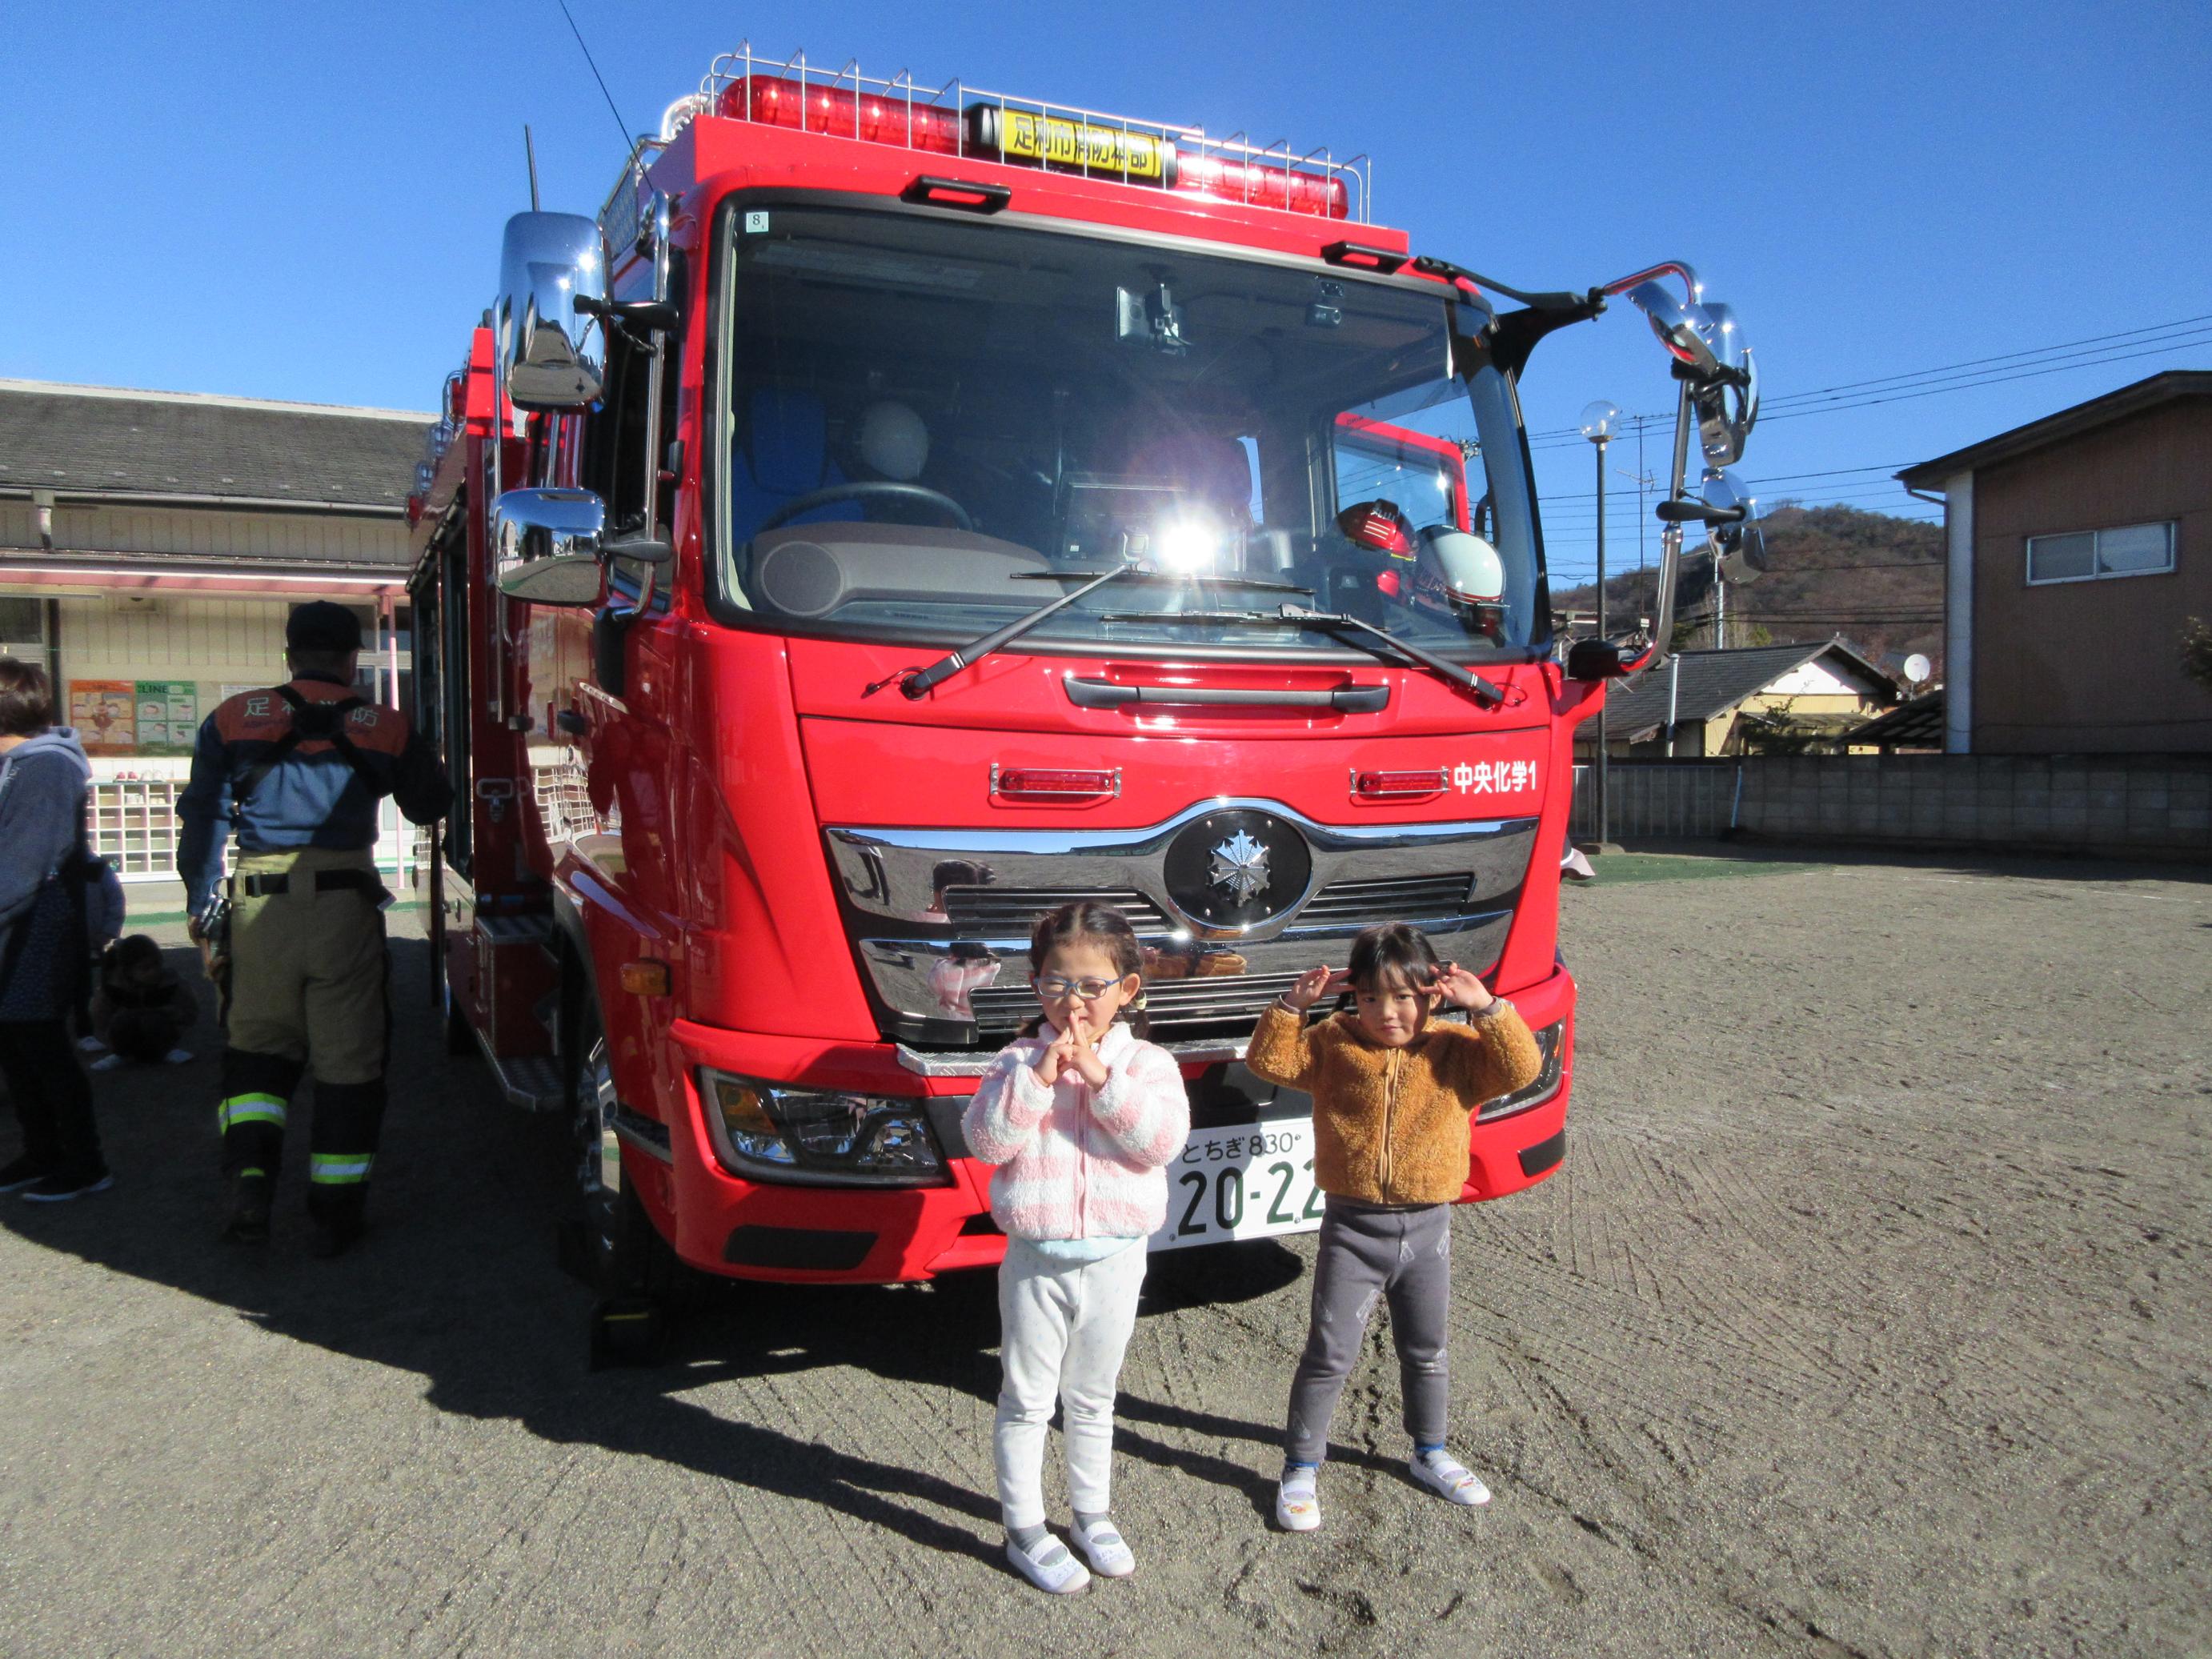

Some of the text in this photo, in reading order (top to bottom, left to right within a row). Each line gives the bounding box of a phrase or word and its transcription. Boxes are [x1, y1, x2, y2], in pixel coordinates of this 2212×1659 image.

[753, 214, 760, 225] 8
[1454, 760, 1537, 795] 中央化学1
[1182, 1132, 1293, 1164] とちぎ 830
